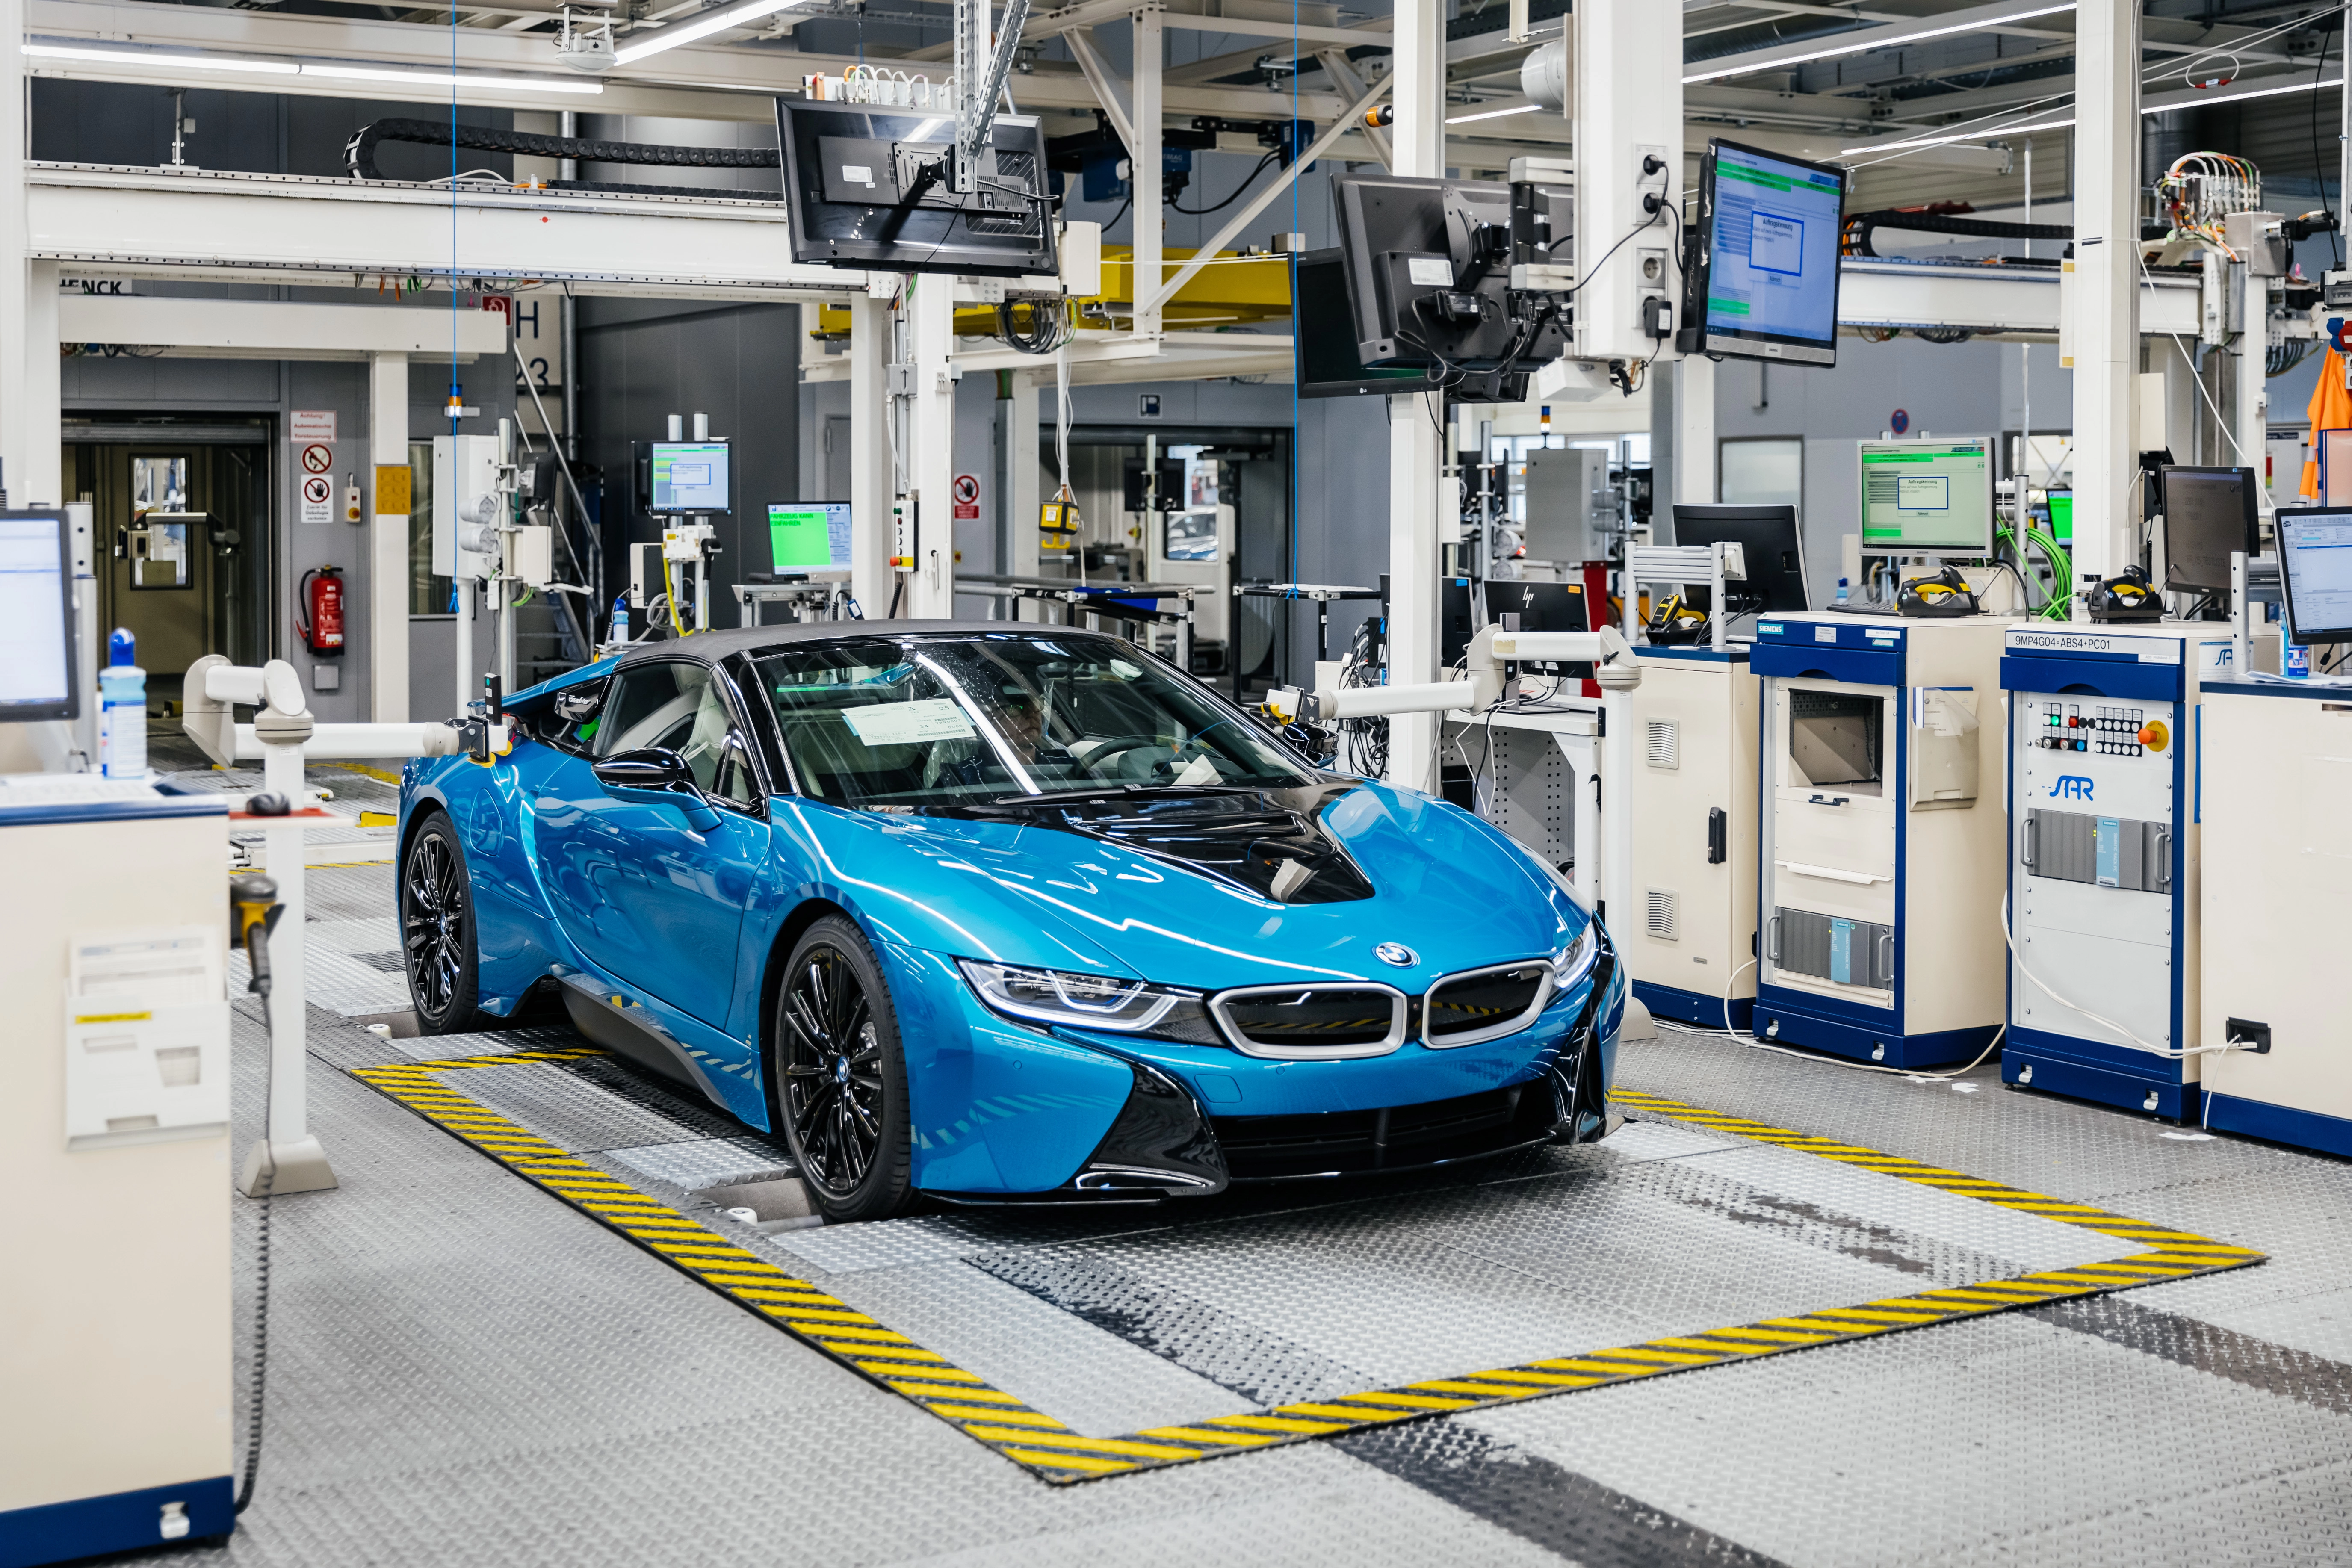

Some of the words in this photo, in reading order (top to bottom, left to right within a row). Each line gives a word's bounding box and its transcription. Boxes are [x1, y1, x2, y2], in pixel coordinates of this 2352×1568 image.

[1763, 218, 1793, 231] Auftragskennung
[61, 278, 122, 294] NCK
[516, 301, 538, 338] H
[1759, 625, 1782, 633] SIEMENS
[568, 695, 591, 705] Roadster
[2049, 775, 2094, 801] SAR
